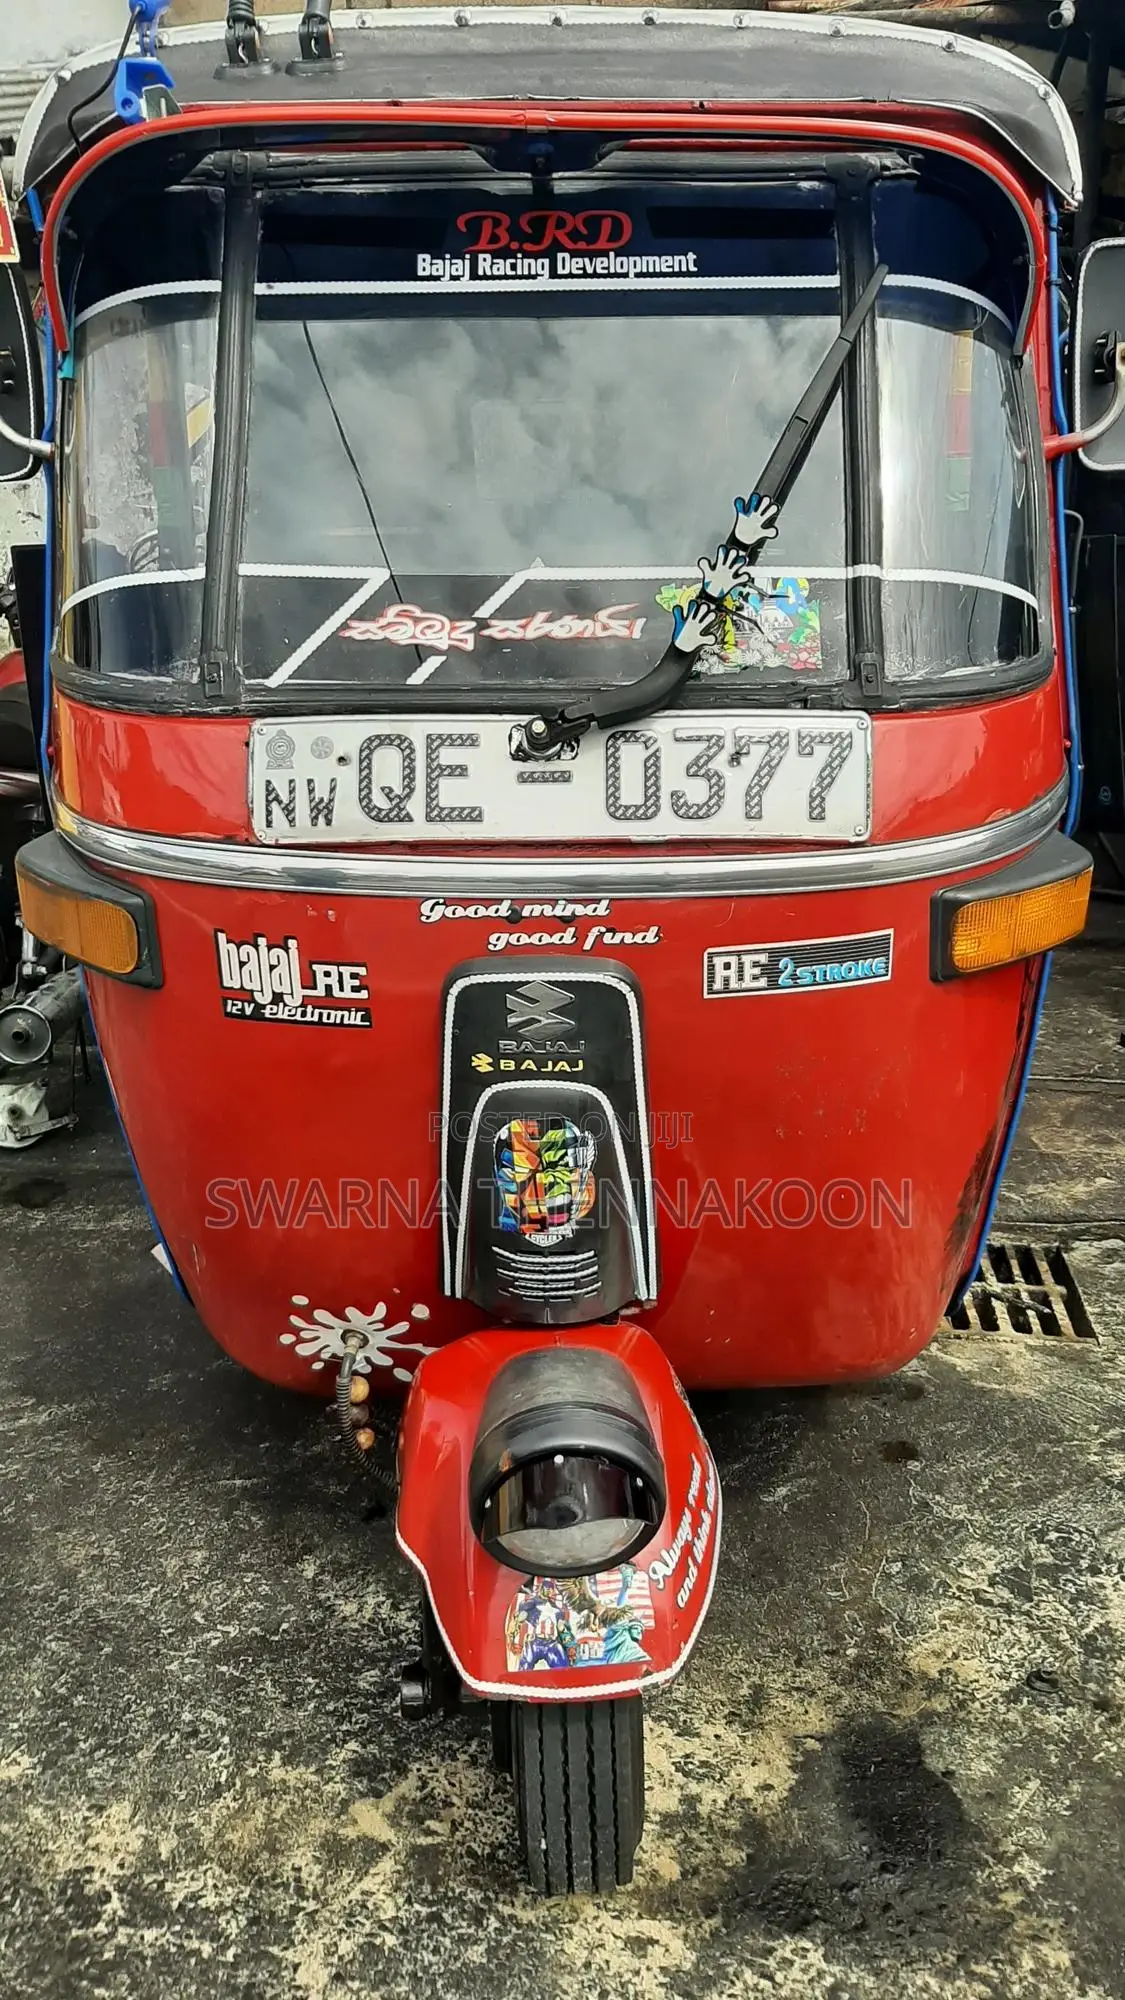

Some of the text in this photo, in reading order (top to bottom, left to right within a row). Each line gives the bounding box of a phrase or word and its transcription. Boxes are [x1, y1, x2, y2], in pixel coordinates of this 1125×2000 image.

[416, 251, 698, 281] Bajaj Racing Development
[265, 778, 337, 828] NW
[358, 733, 484, 823] QE
[605, 727, 853, 821] 0377
[419, 898, 611, 923] Good mind
[487, 926, 661, 951] good find
[216, 931, 369, 1007] bajaj RE
[712, 952, 769, 990] RE
[226, 999, 371, 1026] 12V electronic
[498, 1040, 585, 1054] BAJAJ
[499, 1059, 584, 1072] BAJAJ
[649, 1507, 692, 1590] Always
[677, 1556, 698, 1609] and
[693, 1508, 712, 1564] think
